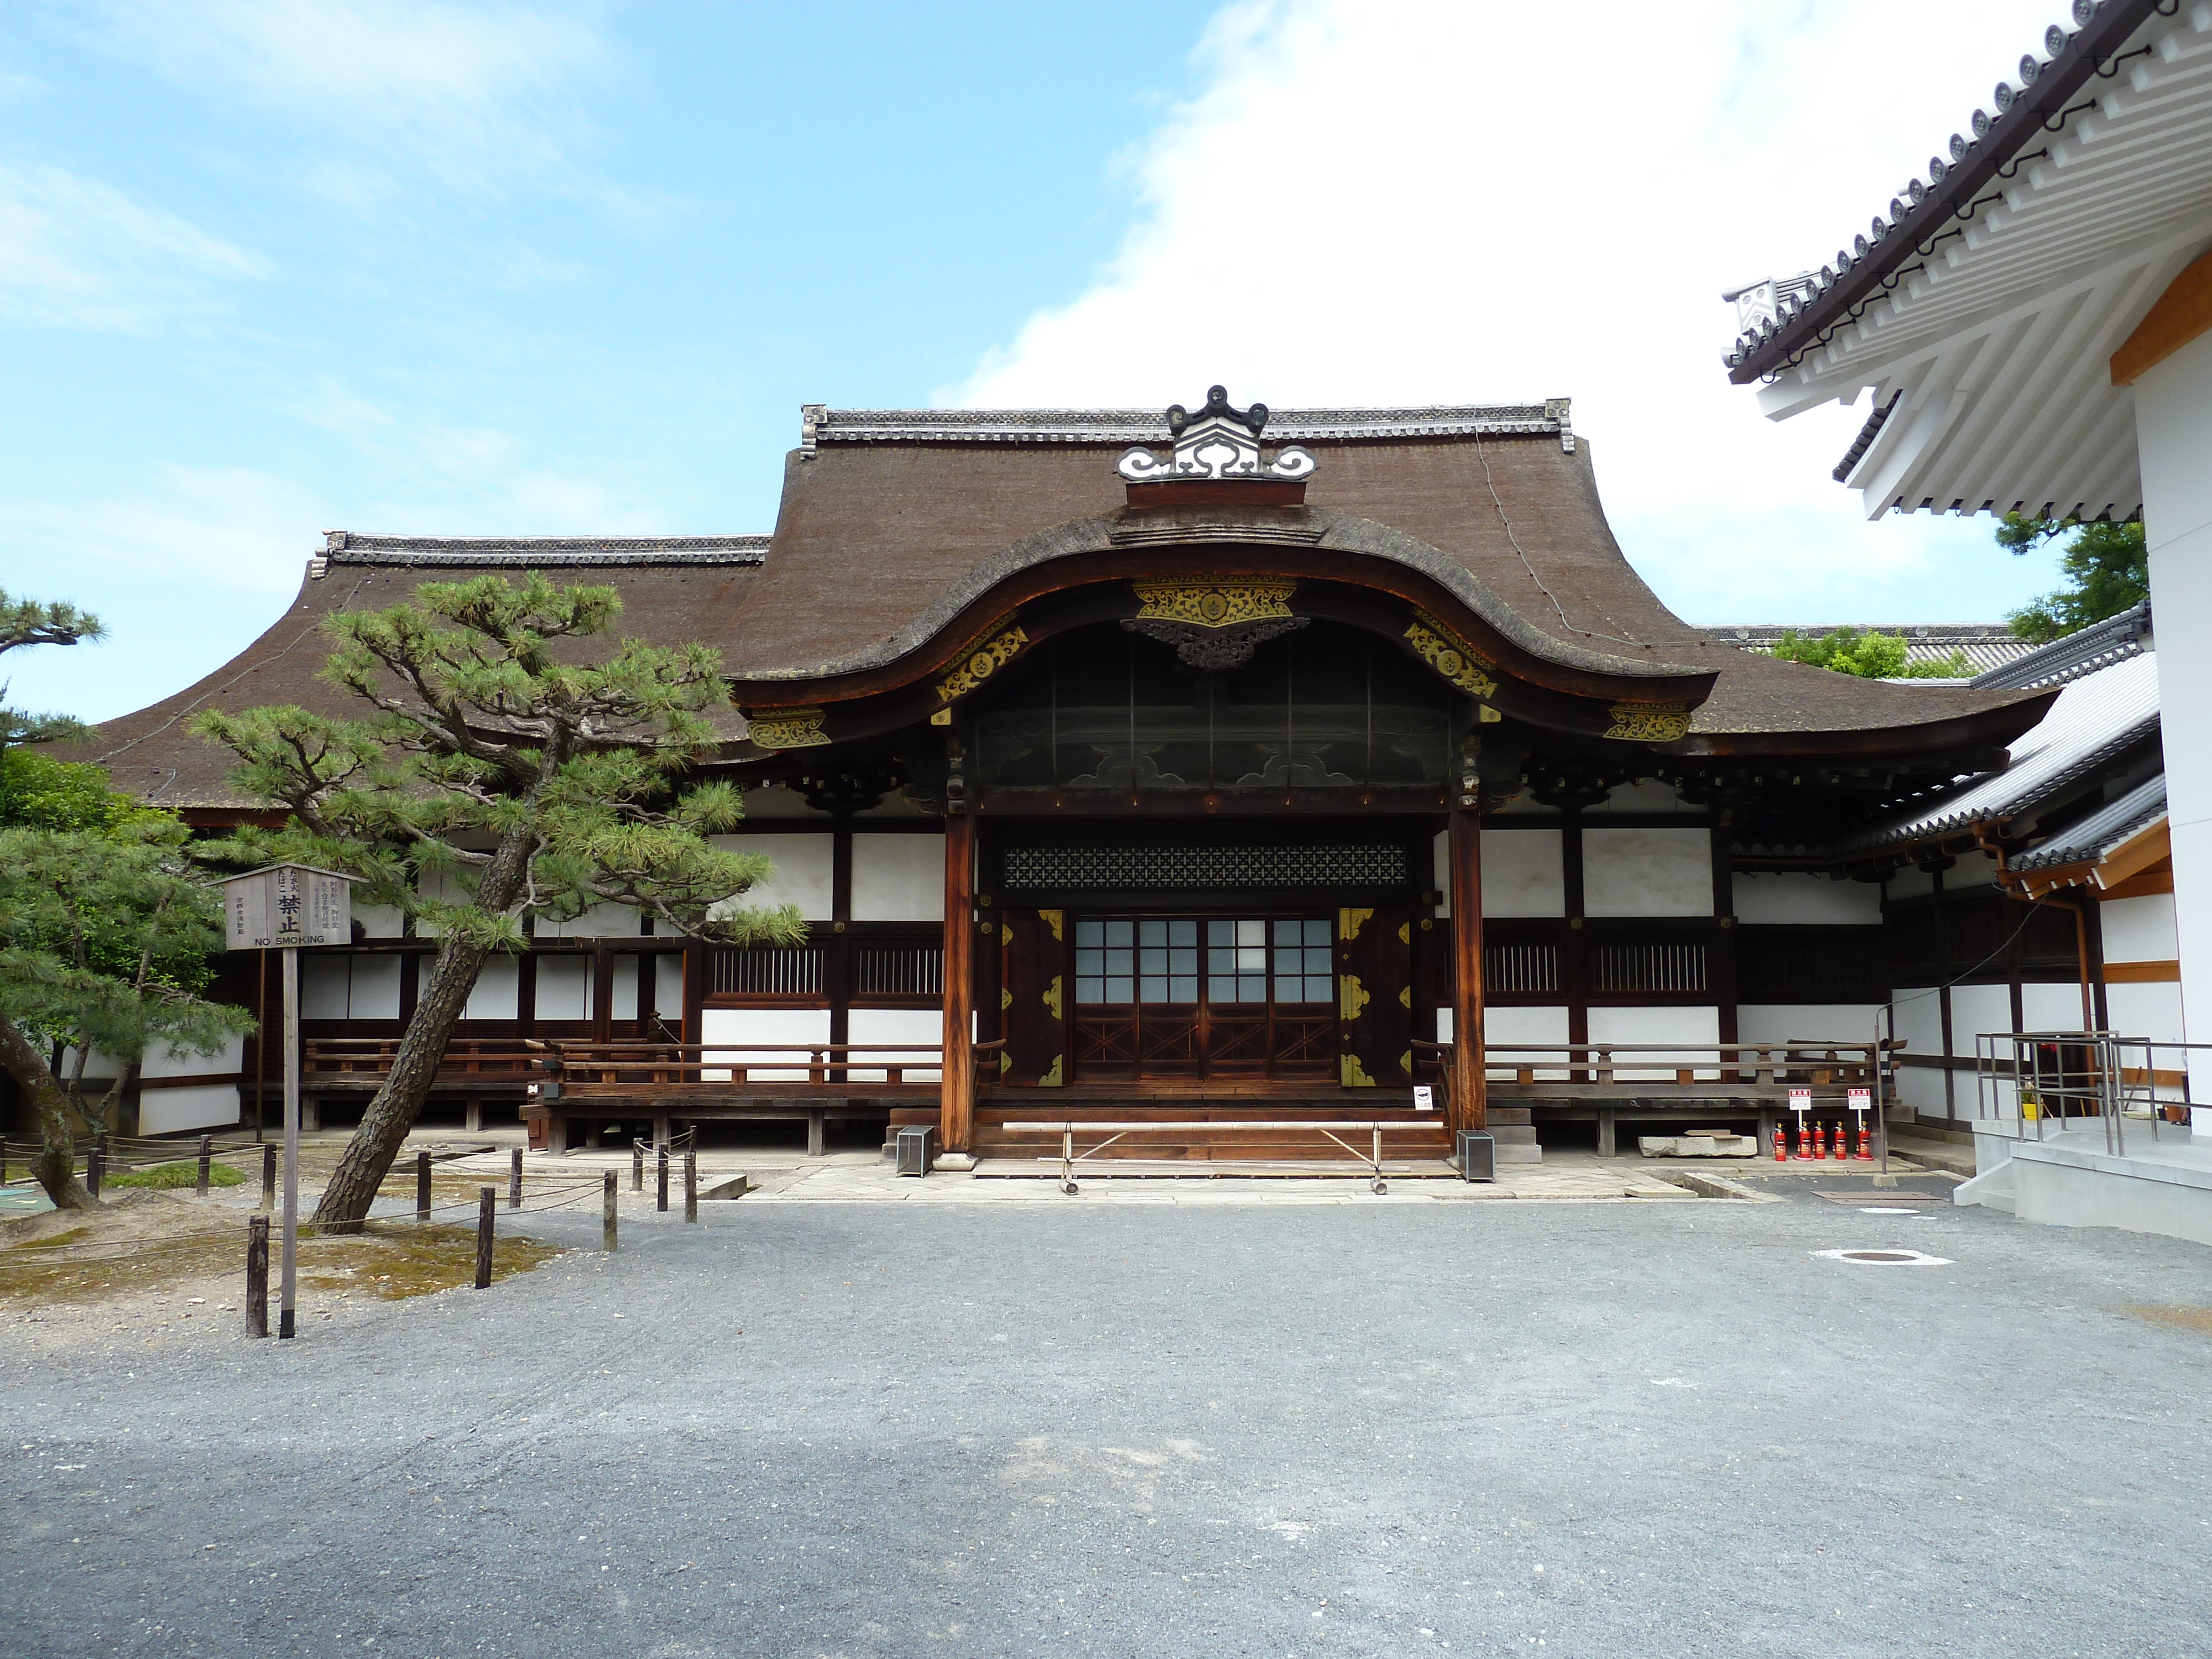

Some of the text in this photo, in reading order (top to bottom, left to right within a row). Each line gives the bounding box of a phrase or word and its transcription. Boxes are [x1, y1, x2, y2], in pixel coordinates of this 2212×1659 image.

[290, 869, 300, 892] たき火
[278, 895, 301, 933] 禁止
[276, 936, 324, 945] SMOKING
